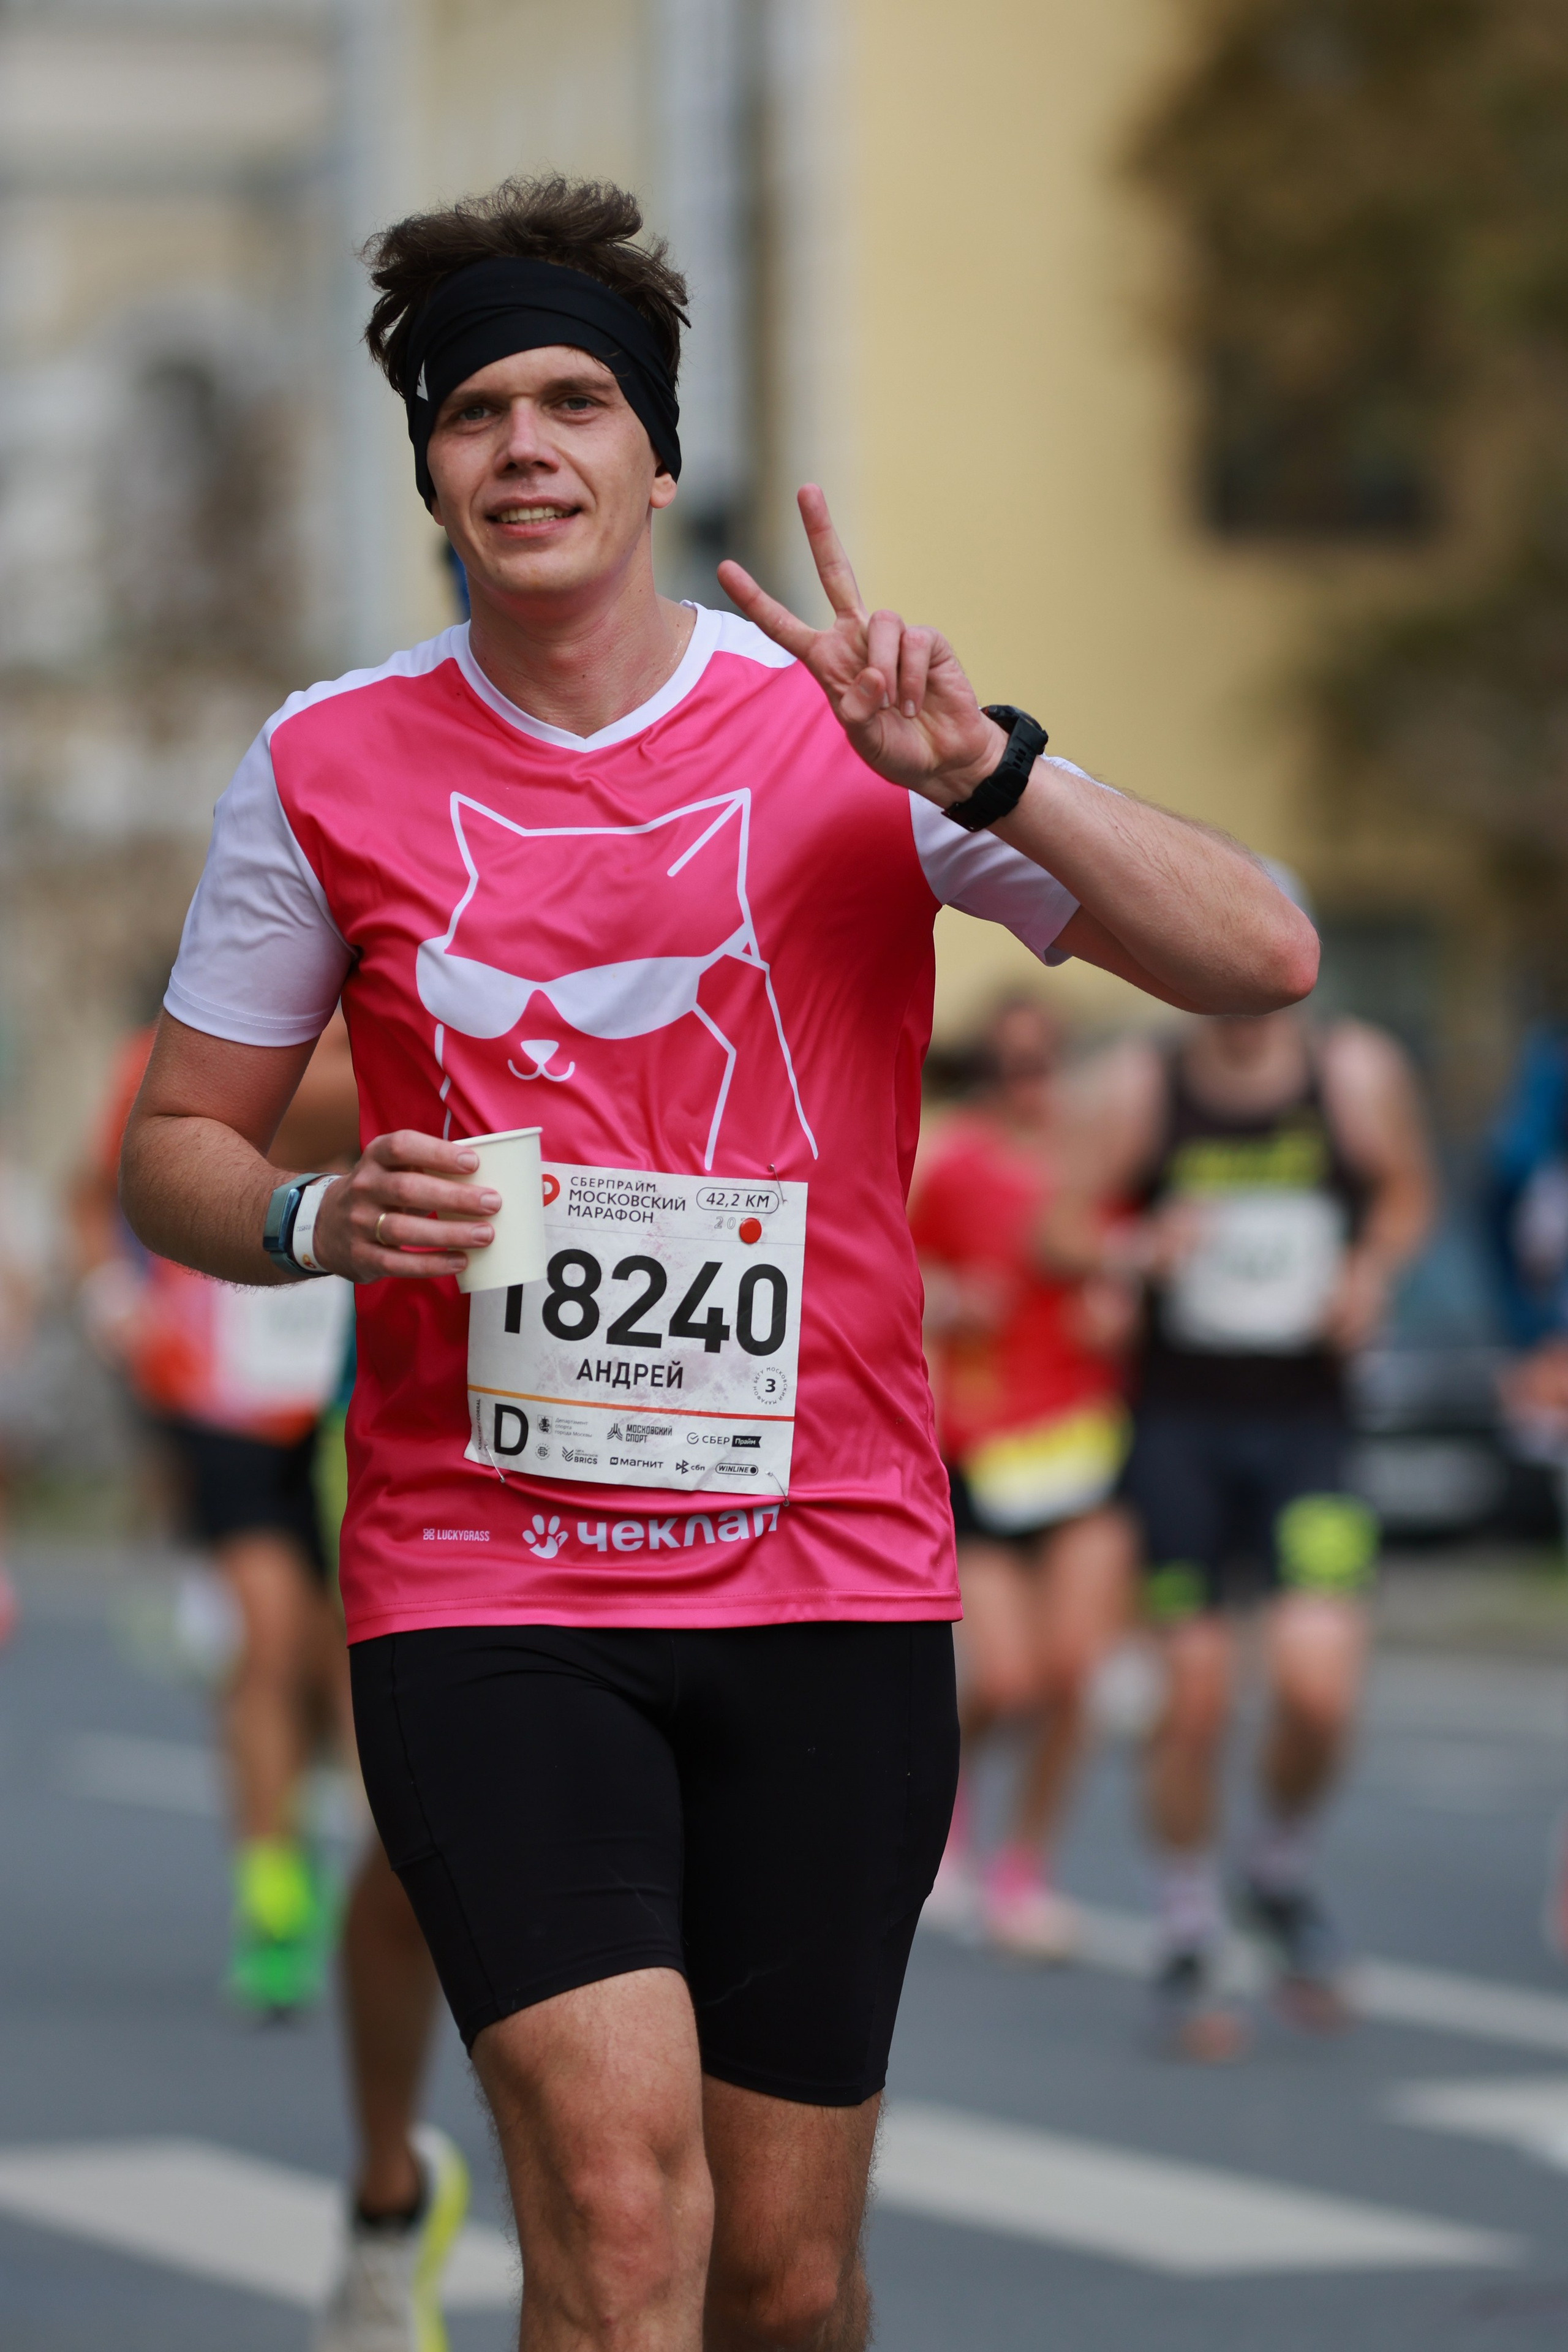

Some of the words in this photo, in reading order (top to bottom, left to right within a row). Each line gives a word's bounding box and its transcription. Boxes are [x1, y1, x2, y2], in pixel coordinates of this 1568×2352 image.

[570, 1175, 656, 1193] СБЕРПРАЙМ
[568, 1189, 686, 1212] МОСКОВСКИЙ
[706, 1192, 741, 1208] 42,2
[567, 1205, 654, 1224] МАРАФОН
[576, 1358, 684, 1390] АНДРЕЙ
[753, 1370, 763, 1384] БЕГУ
[765, 1378, 776, 1393] 3
[753, 1385, 777, 1405] МАРАФОН
[494, 1403, 529, 1456] D
[625, 1423, 673, 1436] МОСКОВСКИЙ
[625, 1433, 647, 1443] СПОРТ
[702, 1435, 730, 1445] СБЕР
[734, 1438, 756, 1446] Прайм
[620, 1458, 664, 1469] магнит
[718, 1465, 749, 1474] WINLINE
[437, 1529, 490, 1542] LUCKYGRASS
[577, 1504, 780, 1553] чеклап
